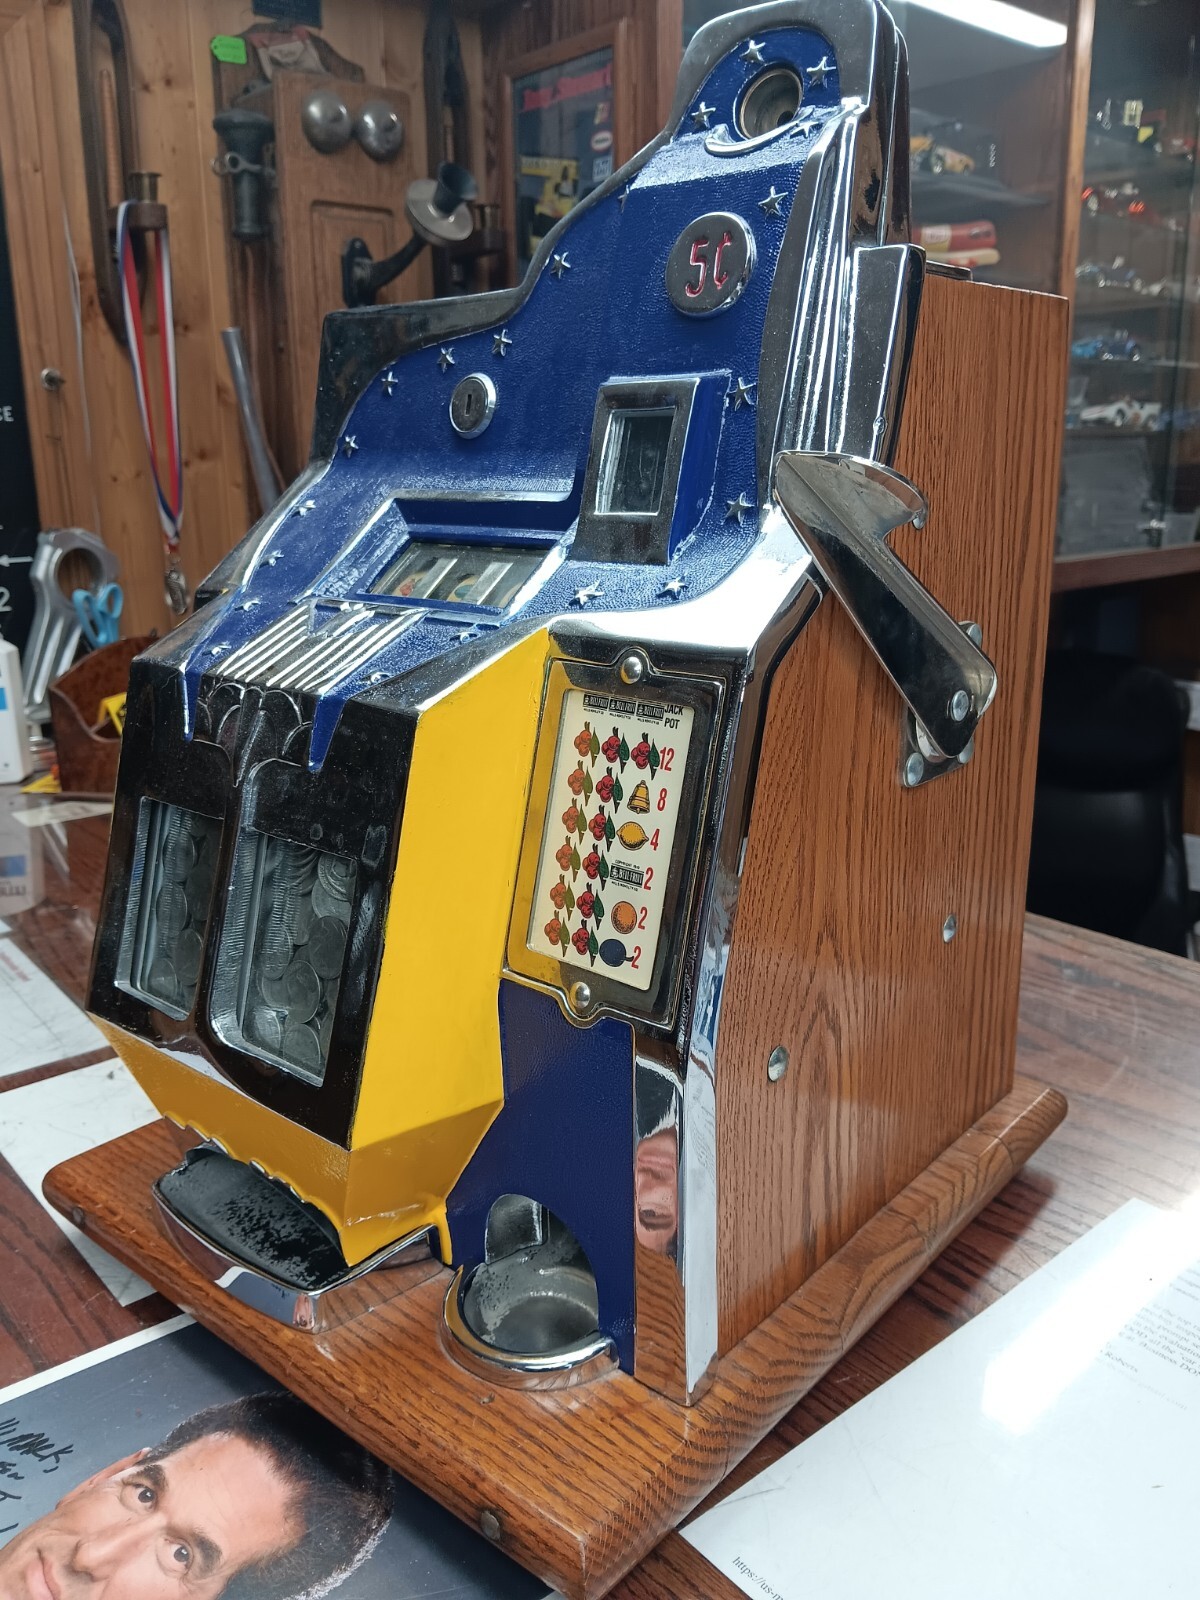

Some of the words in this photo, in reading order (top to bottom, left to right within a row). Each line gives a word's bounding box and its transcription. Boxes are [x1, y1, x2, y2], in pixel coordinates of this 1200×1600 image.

[664, 703, 684, 716] JACK
[664, 717, 680, 729] POT
[659, 747, 675, 772] 12
[657, 788, 668, 812] 8
[650, 828, 660, 851] 4
[643, 866, 654, 891] 2
[637, 906, 648, 930] 2
[631, 945, 642, 970] 2
